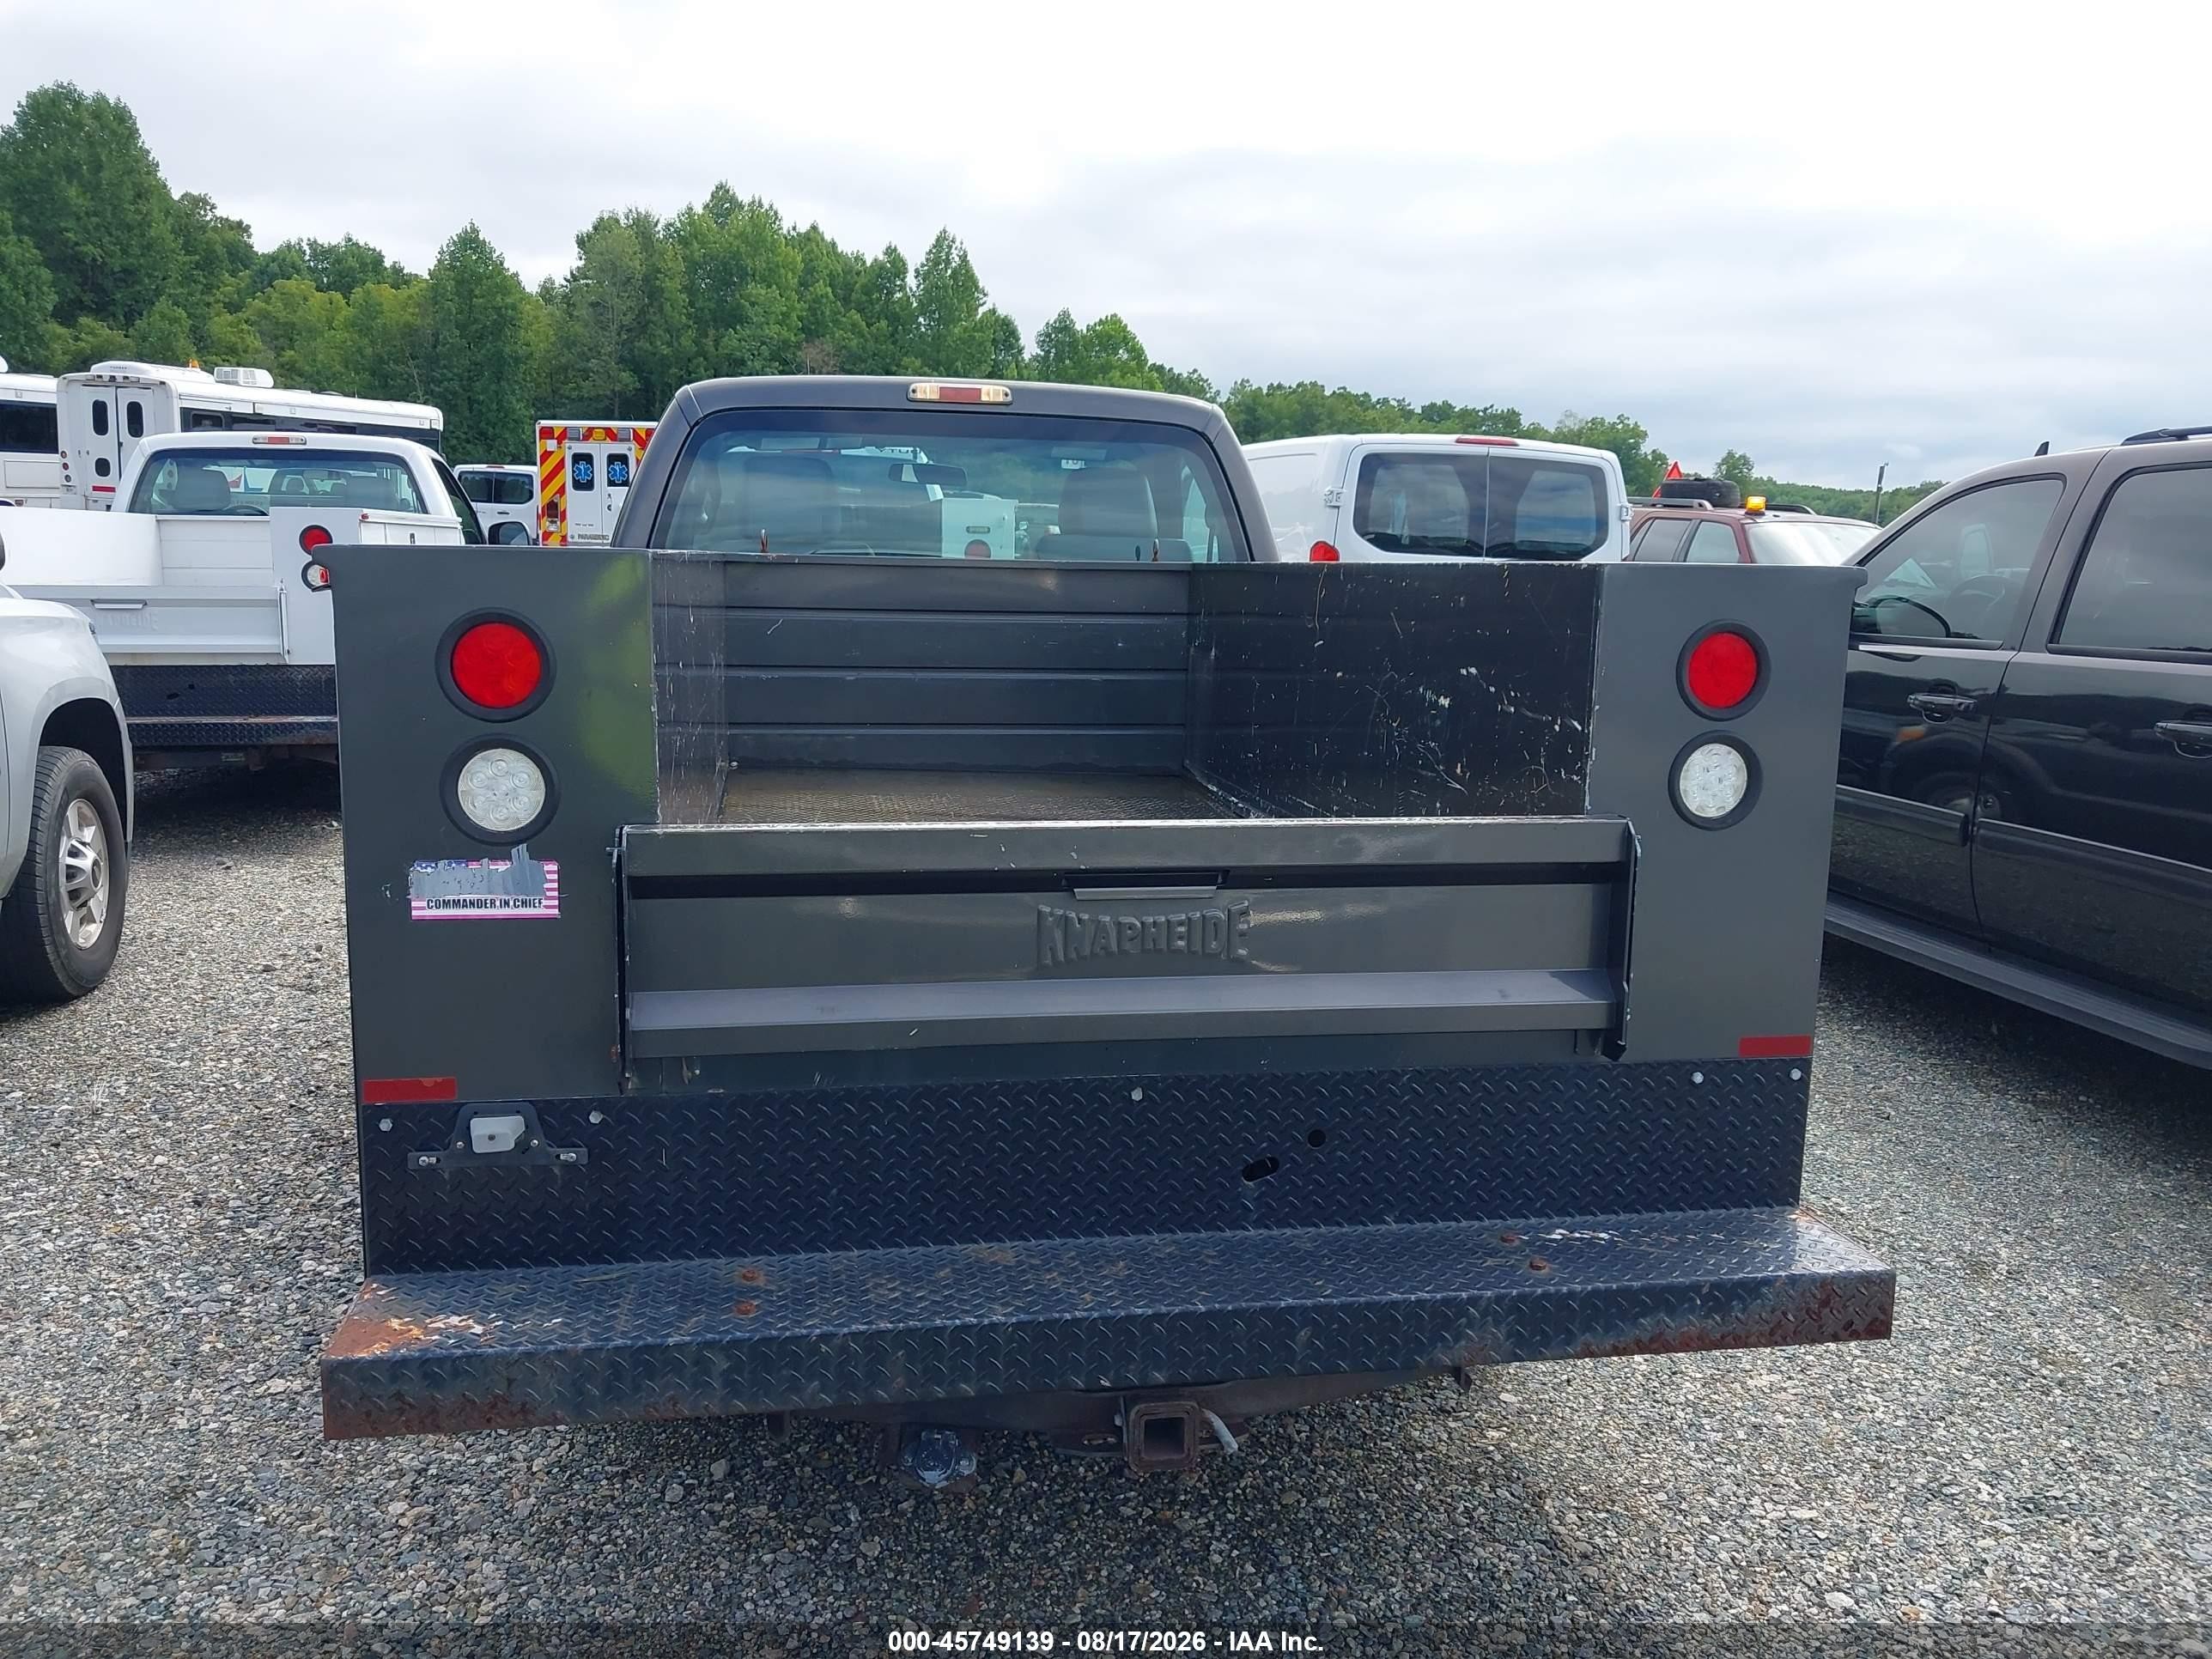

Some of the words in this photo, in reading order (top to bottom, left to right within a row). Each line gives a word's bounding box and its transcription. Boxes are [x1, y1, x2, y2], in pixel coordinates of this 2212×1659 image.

[426, 897, 496, 910] COMMANDER
[499, 897, 510, 909] IN
[513, 897, 544, 909] CHIEF
[1037, 900, 1250, 966] KNAPHEIDE
